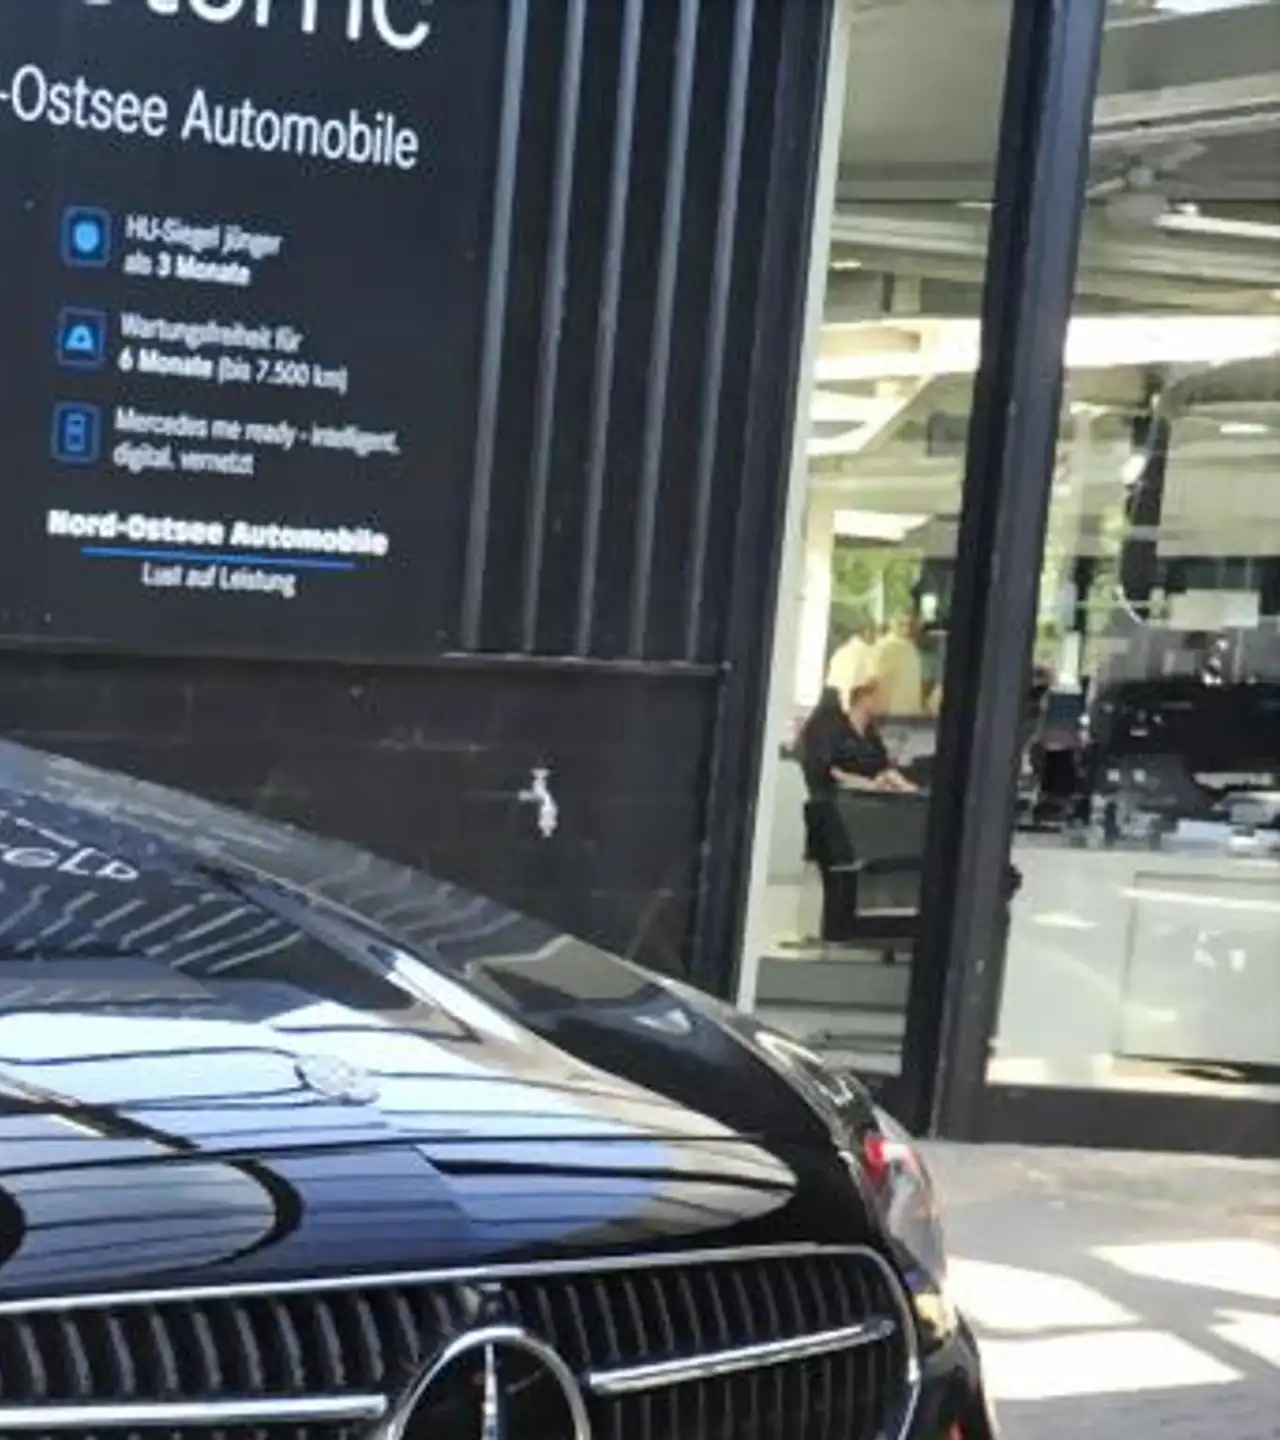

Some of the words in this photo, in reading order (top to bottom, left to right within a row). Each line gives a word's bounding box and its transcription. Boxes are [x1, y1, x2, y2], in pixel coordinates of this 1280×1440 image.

[180, 89, 420, 170] Automobile
[117, 346, 134, 374] 6
[46, 508, 226, 548] Nord-Ostsee
[228, 520, 390, 556] Automobile
